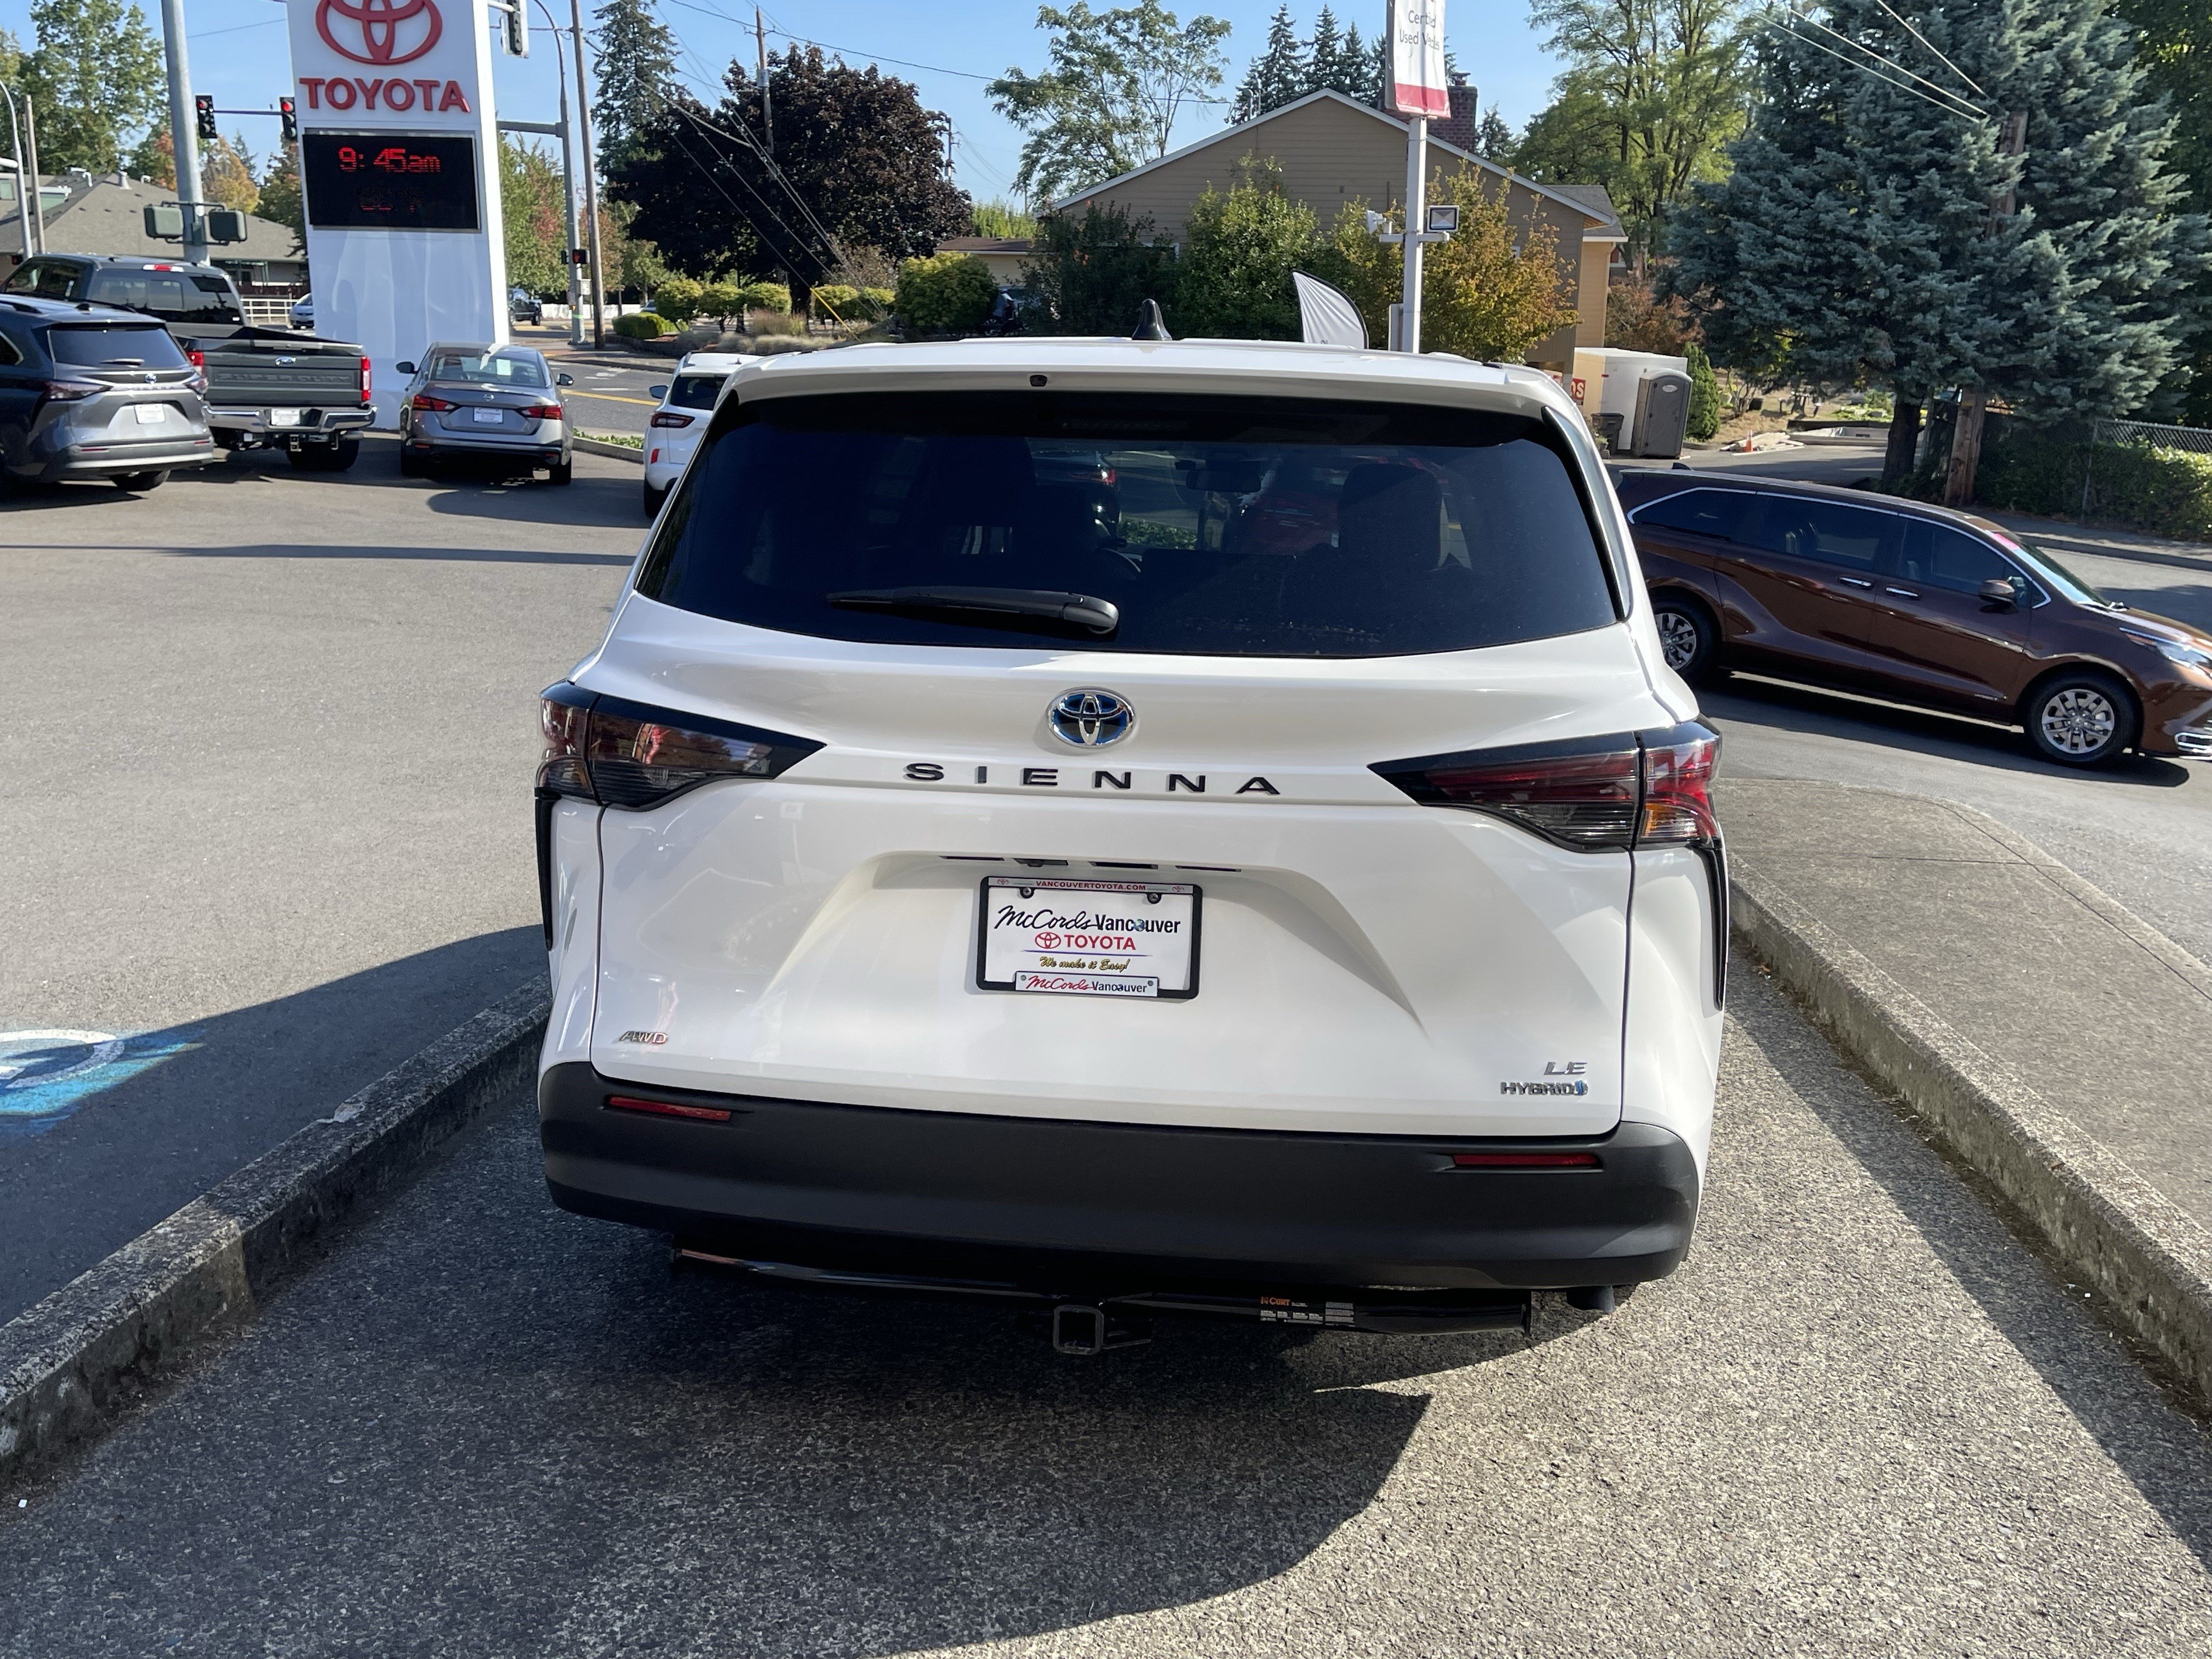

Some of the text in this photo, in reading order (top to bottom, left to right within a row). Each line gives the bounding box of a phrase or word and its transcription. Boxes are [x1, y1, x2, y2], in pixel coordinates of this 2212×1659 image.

[1400, 29, 1419, 45] Used
[299, 77, 471, 112] TOYOTA
[905, 763, 1281, 795] SIENNA
[1036, 880, 1146, 891] VANCOUVERTOYOTA.COM
[994, 905, 1181, 934] McCords Vancouver
[1064, 934, 1137, 951] TOYOTA
[1039, 956, 1057, 967] We
[1059, 958, 1086, 969] make
[1099, 958, 1131, 973] Easy!
[1025, 975, 1148, 994] McCords Vancouver
[618, 1030, 669, 1045] AWD
[1544, 1061, 1588, 1076] LE
[1500, 1081, 1576, 1096] HYBRID
